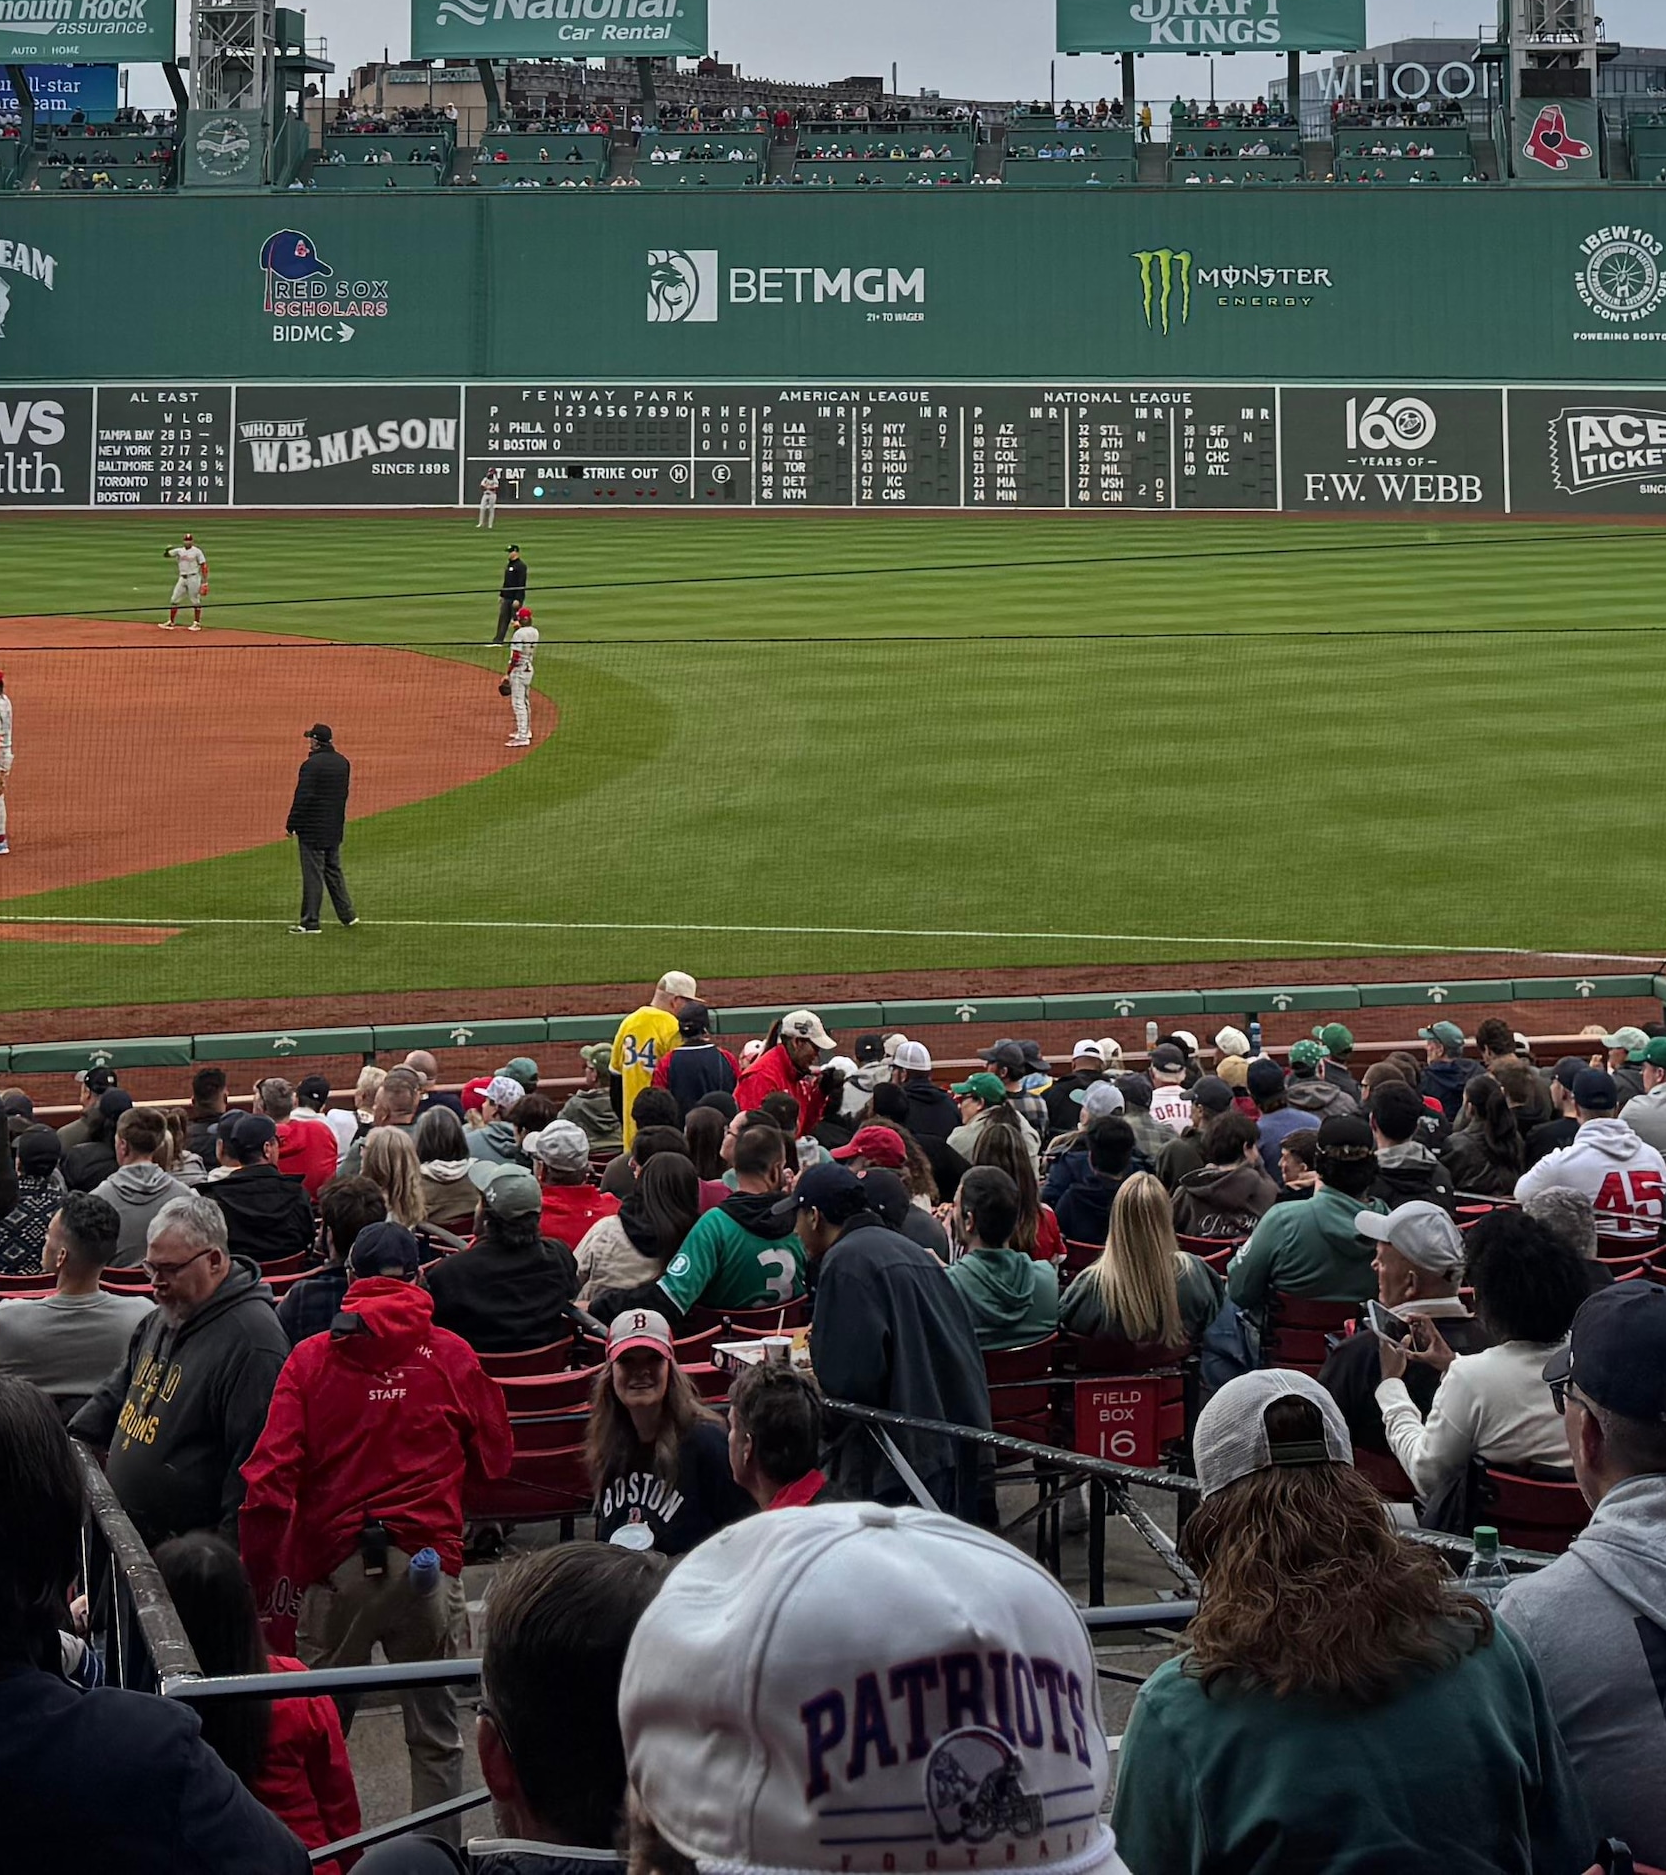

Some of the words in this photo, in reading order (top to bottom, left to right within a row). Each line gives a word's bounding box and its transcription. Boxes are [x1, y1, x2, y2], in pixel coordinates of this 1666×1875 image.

[557, 24, 594, 42] Car
[600, 23, 672, 41] Rental
[1148, 17, 1282, 45] KINGS
[11, 46, 37, 55] AUTO
[51, 45, 80, 55] HOME
[1579, 226, 1630, 256] IBEW
[1632, 229, 1664, 256] 103
[275, 280, 326, 300] RED
[335, 279, 389, 299] SOX
[729, 267, 925, 303] BETMGM
[1574, 271, 1593, 307] NECA
[273, 300, 389, 317] SCHOLARS
[1218, 297, 1312, 306] ENERGY
[273, 325, 334, 342] BIDMC
[1573, 332, 1630, 341] POWERING
[130, 392, 150, 403] AL
[158, 392, 200, 402] EAST
[522, 390, 617, 402] FENWAY
[634, 390, 694, 402] PARK
[778, 390, 860, 402] AMERICAN
[868, 391, 930, 403] LEAGUE
[1044, 392, 1123, 404] NATIONAL
[1130, 393, 1193, 404] LEAGUE
[240, 423, 270, 439] WHO
[273, 422, 305, 438] BUT
[1346, 396, 1437, 450] 160
[503, 439, 547, 451] BOSTON
[371, 463, 415, 475] SINCE
[1360, 456, 1402, 466] YEARS
[1407, 457, 1425, 466] OF
[583, 468, 626, 480] STRIKE
[631, 468, 659, 480] OUT
[1303, 473, 1366, 502] F.W.
[1374, 473, 1484, 503] WEBB
[757, 1250, 798, 1308] 3
[369, 1388, 407, 1401] STAFF
[1092, 1390, 1142, 1406] FIELD
[1099, 1408, 1135, 1422] BOX
[1100, 1429, 1136, 1458] 16
[603, 1471, 684, 1523] BOSTON
[799, 1650, 1093, 1805] PATRIOTS
